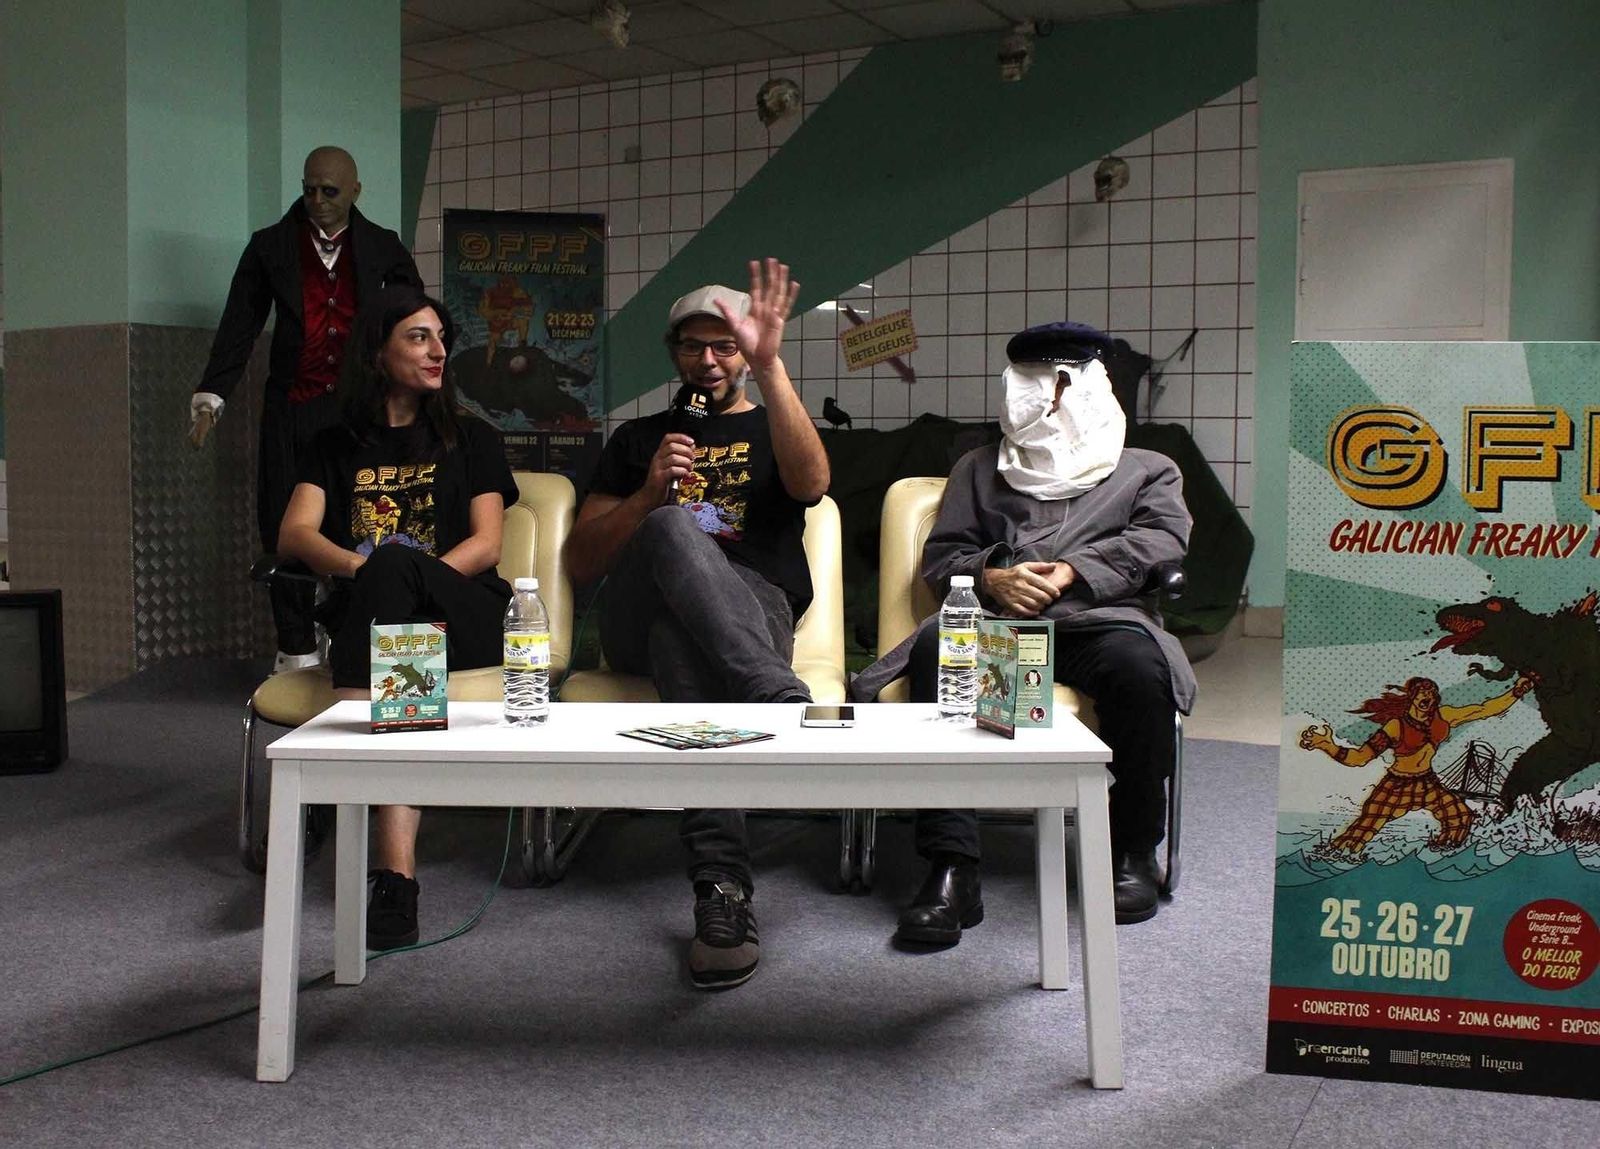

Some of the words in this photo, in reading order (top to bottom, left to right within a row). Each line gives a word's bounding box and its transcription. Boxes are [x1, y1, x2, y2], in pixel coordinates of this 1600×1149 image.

[459, 230, 589, 263] GFFF
[458, 261, 498, 273] GALICIAN
[498, 262, 528, 274] FREAKY
[530, 263, 550, 274] FILM
[552, 264, 589, 276] FESTIVAL
[846, 318, 909, 348] BETELGEUSE
[850, 334, 912, 363] BETELGEUSE
[529, 435, 538, 445] 22
[575, 436, 585, 446] 23
[1326, 404, 1600, 513] GF
[355, 463, 436, 485] GFFF
[354, 484, 378, 493] GALICIAN
[378, 484, 400, 492] FREAKY
[1329, 518, 1465, 556] GALICIAN
[1466, 521, 1590, 560] FREAKY
[1526, 910, 1557, 922] Cinema
[1528, 921, 1582, 936] Underground
[1539, 933, 1561, 945] Serie
[1332, 942, 1451, 982] OUTUBRO
[1522, 947, 1532, 960] O
[1533, 947, 1583, 965] MELLOR
[1522, 963, 1541, 977] DO
[1542, 964, 1581, 981] PEOR!
[1302, 999, 1370, 1017] CONCERTOS
[1387, 1005, 1440, 1023] CHARLAS
[1458, 1011, 1490, 1026] ZONA
[1493, 1013, 1541, 1030] GAMING
[1420, 1051, 1471, 1062] DEPUTACIÓN
[1420, 1058, 1472, 1069] PONTEVEDRA
[1481, 1054, 1524, 1074] lingua
